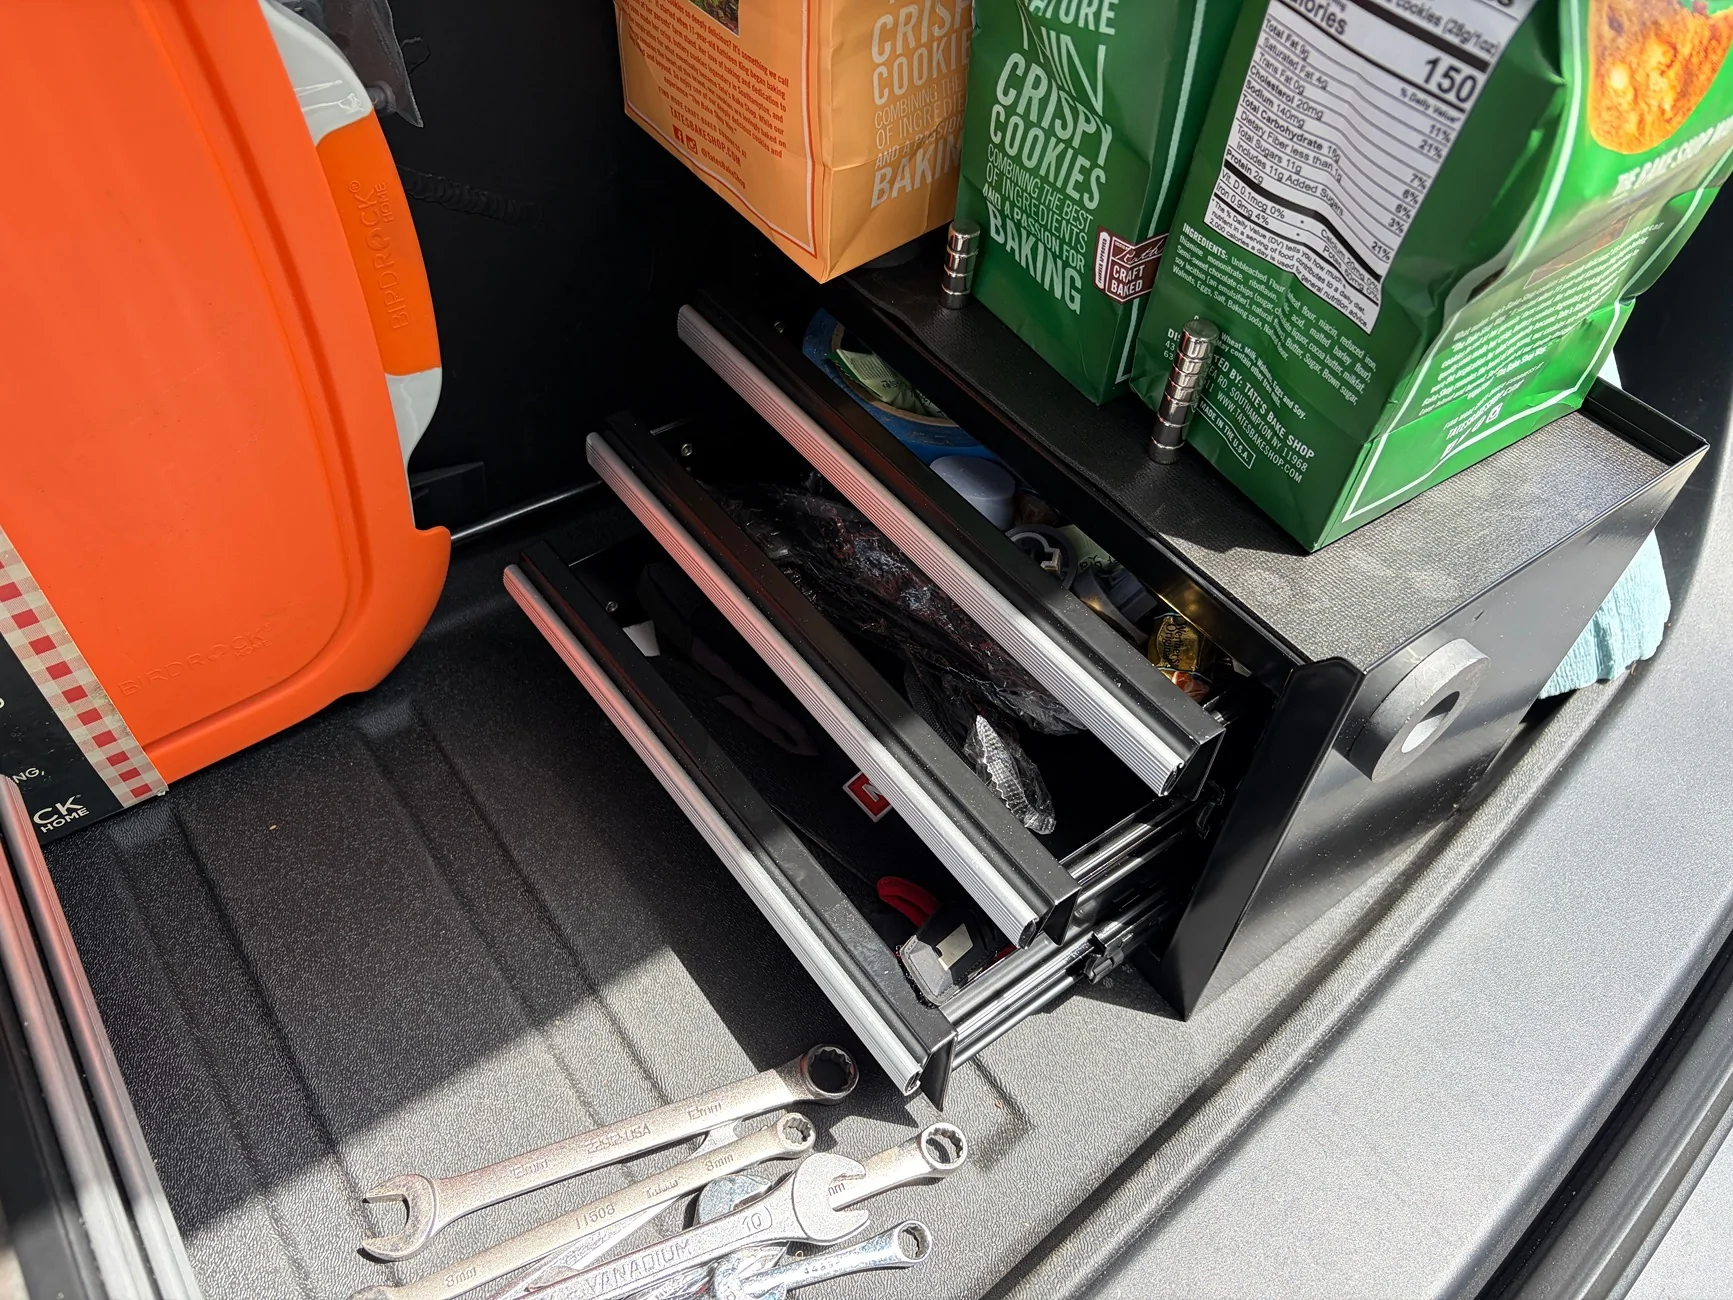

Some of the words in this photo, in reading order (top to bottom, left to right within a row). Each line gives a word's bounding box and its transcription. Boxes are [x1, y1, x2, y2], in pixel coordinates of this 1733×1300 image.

[738, 61, 749, 76] King
[750, 68, 766, 87] began
[766, 80, 786, 101] baking
[741, 50, 768, 76] something
[769, 71, 777, 80] we
[778, 75, 789, 88] call
[742, 77, 751, 89] and
[752, 84, 779, 109] dedication
[780, 102, 787, 113] to
[1259, 53, 1279, 75] Trans
[1279, 71, 1293, 87] Fat
[1293, 81, 1306, 96] 0g
[1265, 18, 1285, 39] Total
[1285, 33, 1298, 50] Fat
[1430, 124, 1451, 144] 11%
[1424, 56, 1477, 104] 150
[772, 112, 783, 124] and
[875, 84, 938, 129] COMBINING
[996, 52, 1113, 167] CRISPY
[1242, 94, 1260, 115] Total
[1260, 110, 1323, 151] Carbohydrate
[1245, 79, 1274, 109] Sodium
[1276, 104, 1305, 129] 140mg
[1262, 36, 1299, 70] Saturated
[1300, 64, 1314, 81] Fat
[1316, 76, 1328, 91] 4g
[1419, 139, 1443, 160] 21%
[761, 127, 777, 144] baked
[778, 139, 787, 149] on
[771, 147, 783, 159] and
[773, 126, 784, 136] our
[876, 123, 893, 149] OF
[1237, 124, 1255, 145] Total
[1254, 138, 1283, 164] Sugars
[1286, 158, 1303, 175] 11g
[1250, 64, 1295, 105] Cholesterol
[1296, 99, 1324, 120] 20mg
[1410, 173, 1427, 190] 7%
[876, 143, 899, 169] AND
[902, 141, 910, 154] A
[989, 104, 1106, 210] COOKIES
[1226, 149, 1253, 176] Protein
[1253, 170, 1264, 186] 2g
[1240, 111, 1266, 138] Dietary
[1267, 132, 1289, 151] Fiber
[1290, 144, 1310, 161] less
[1313, 155, 1333, 172] than
[1388, 217, 1405, 234] 3%
[986, 162, 999, 187] OF
[1002, 176, 1088, 253] INGREDIENTS
[987, 143, 1041, 199] COMBINING
[1042, 183, 1063, 214] THE
[1063, 198, 1093, 233] BEST
[1216, 182, 1230, 198] Iron
[1230, 193, 1254, 219] 0.9mg
[1254, 212, 1269, 226] 4%
[1222, 169, 1232, 184] Vit.
[1233, 180, 1240, 190] D
[1240, 186, 1268, 213] 0.1mcg
[1269, 205, 1285, 220] 0%
[1236, 141, 1267, 169] Includes
[1269, 165, 1285, 182] 11g
[1285, 174, 1319, 194] Added
[1320, 188, 1344, 217] Sugars
[1371, 241, 1391, 261] 21%
[982, 183, 1000, 209] AND
[1004, 204, 1011, 219] A
[1014, 209, 1060, 256] PASSION
[1062, 247, 1085, 274] FOR
[1249, 225, 1267, 241] Value
[1267, 235, 1284, 250] (DV)
[1312, 258, 1326, 273] how
[1320, 228, 1346, 261] Calcium
[987, 201, 1082, 315] BAKING
[1113, 264, 1145, 283] CRAFT
[1226, 229, 1250, 250] calories
[1301, 273, 1324, 295] general
[1245, 233, 1269, 252] serving
[1278, 247, 1295, 262] food
[1295, 256, 1326, 285] contributes
[1111, 280, 1143, 297] BAKED
[1172, 265, 1196, 287] Walnuts,
[1196, 281, 1213, 298] Eggs,
[1213, 291, 1226, 306] Salt,
[1227, 299, 1249, 320] Baking
[1180, 234, 1204, 257] thiamine
[1207, 255, 1244, 282] mononitrate,
[1248, 279, 1278, 302] riboflavin,
[1291, 313, 1306, 330] acid,
[1309, 328, 1331, 348] malted
[1332, 345, 1352, 366] barley
[1182, 222, 1229, 261] INGREDIENTS:
[1231, 256, 1268, 283] Unbleached
[1268, 278, 1286, 293] Flour
[1301, 305, 1317, 323] flour,
[1318, 318, 1338, 340] niacin,
[1340, 336, 1365, 359] reduced
[1364, 354, 1377, 372] iron,
[1176, 245, 1209, 272] Semi-sweet
[1209, 267, 1237, 287] chocolate
[1236, 282, 1254, 298] chips
[1291, 327, 1309, 348] liquor,
[1308, 342, 1326, 360] cocoa
[1324, 355, 1344, 376] butter,
[1342, 371, 1365, 394] milkfat,
[1185, 262, 1206, 281] lecithin
[1251, 303, 1273, 322] natural
[1285, 337, 1304, 360] Butter,
[1303, 353, 1322, 374] Sugar,
[1321, 368, 1341, 389] Brown
[1339, 385, 1358, 406] sugar,
[1230, 348, 1252, 368] contain
[1200, 400, 1216, 421] MADE
[1223, 425, 1235, 442] THE
[1232, 438, 1249, 462] U.S.A.
[1217, 374, 1228, 391] RD.
[1229, 387, 1273, 440] SOUTHAMPTON
[1271, 436, 1282, 450] NY
[1282, 447, 1308, 472] 11968
[1217, 392, 1303, 484] WWW.TATESBAKESHOP.COM
[1229, 369, 1243, 387] BY:
[1244, 382, 1268, 414] TATE'S
[1266, 411, 1287, 439] BAKE
[1286, 434, 1315, 459] SHOP
[40, 807, 91, 834] HOME
[585, 1238, 694, 1294] VANADIUM
